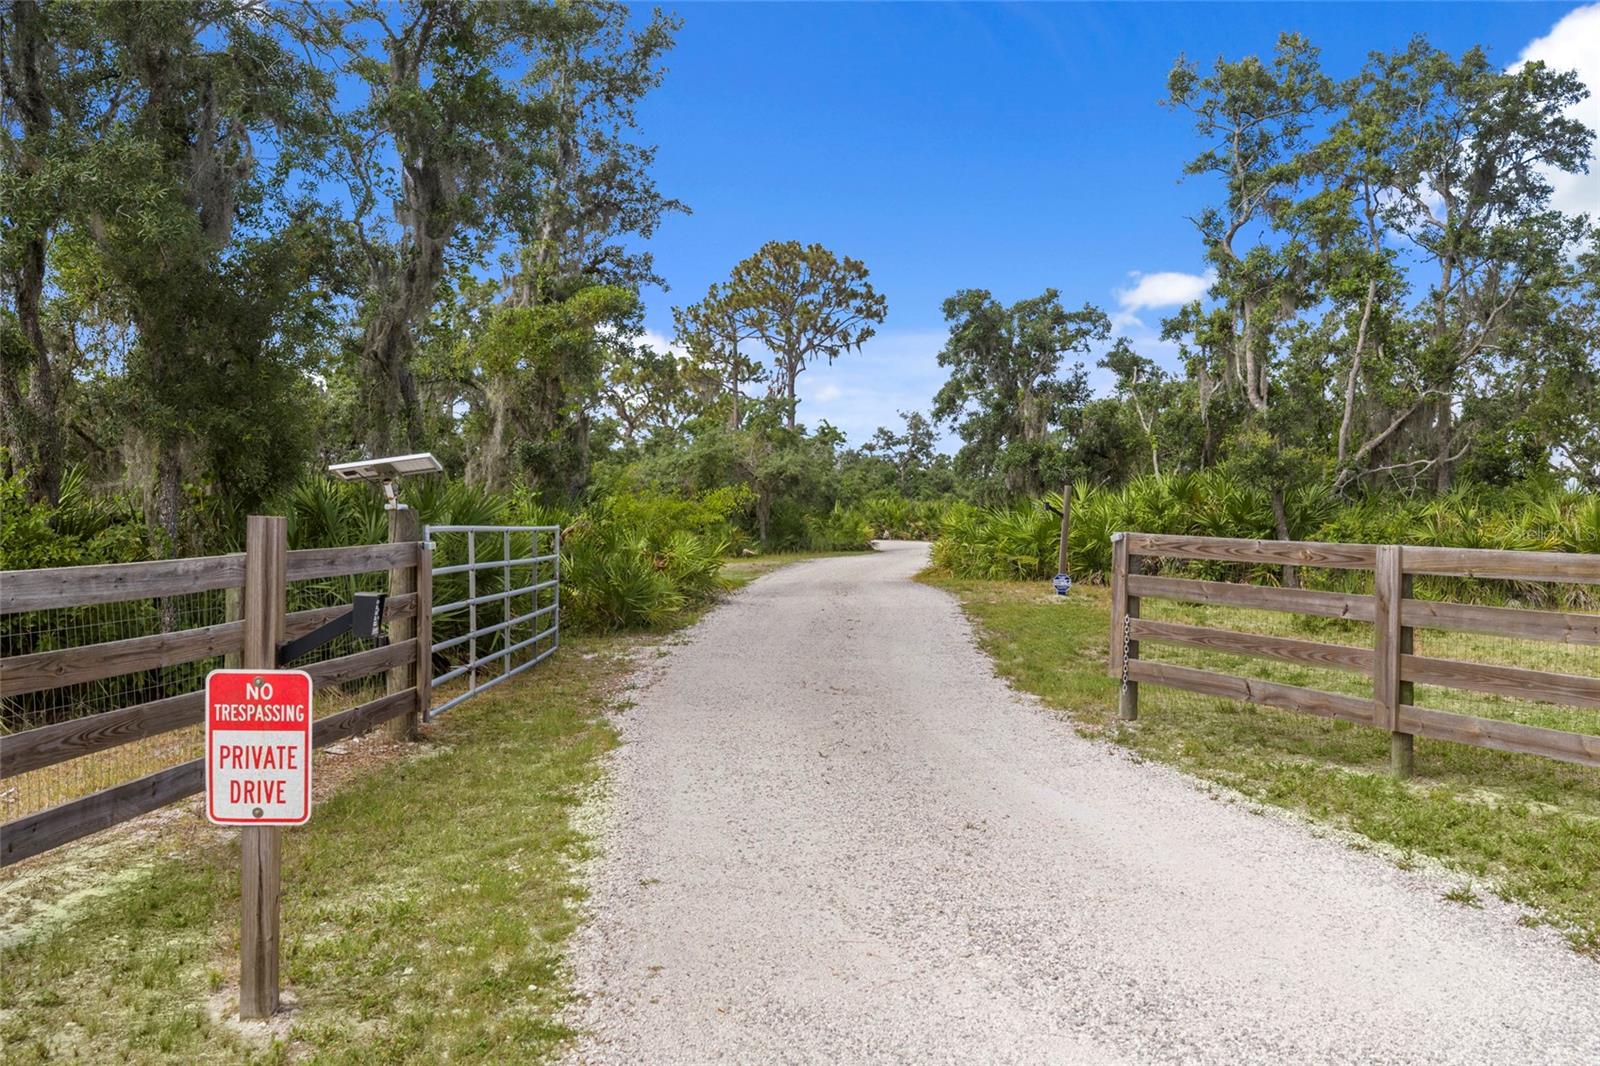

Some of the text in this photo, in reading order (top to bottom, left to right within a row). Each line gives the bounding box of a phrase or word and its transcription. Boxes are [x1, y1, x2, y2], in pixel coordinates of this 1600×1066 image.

[246, 683, 273, 700] NO
[214, 704, 305, 722] TRESPASSING
[219, 745, 298, 770] PRIVATE
[230, 780, 287, 804] DRIVE
